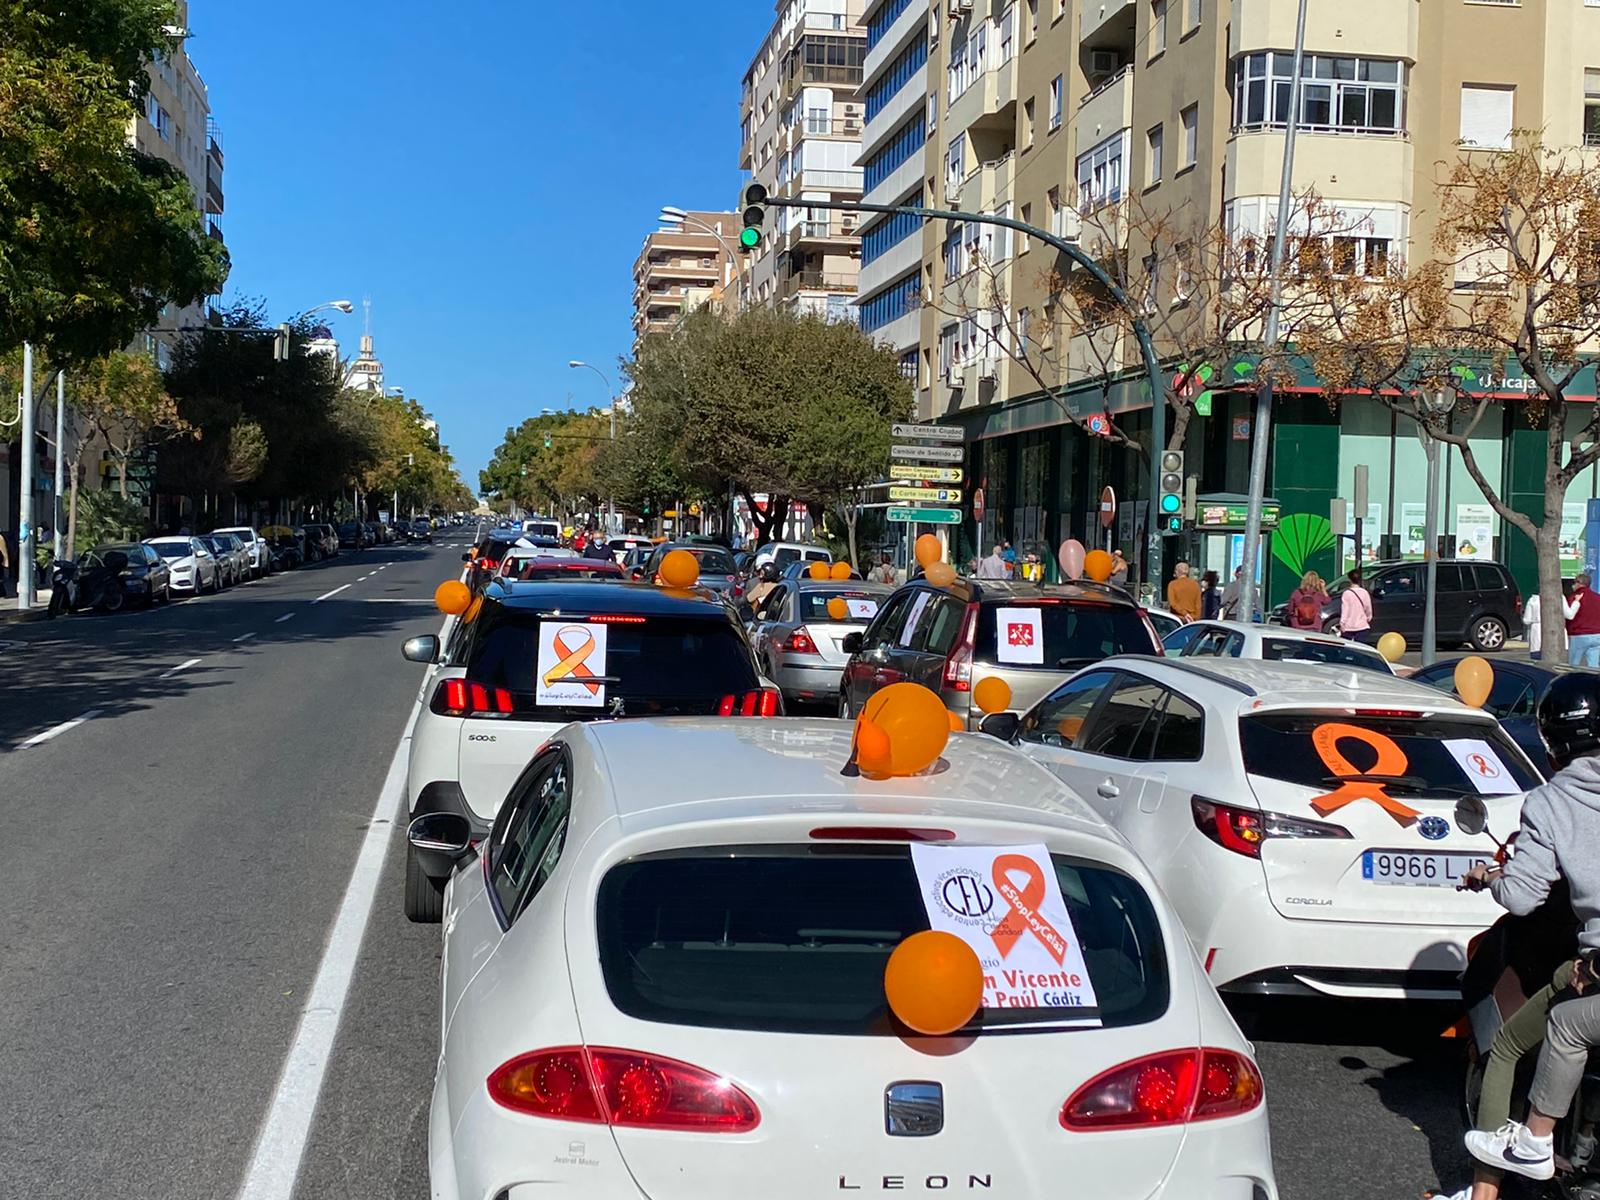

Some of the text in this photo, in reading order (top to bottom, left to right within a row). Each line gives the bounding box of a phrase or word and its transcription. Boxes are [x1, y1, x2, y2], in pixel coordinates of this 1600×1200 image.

[912, 426, 937, 434] Centro
[1378, 855, 1437, 879] 9966
[1285, 897, 1333, 905] COROLLA
[1002, 970, 1081, 988] Vicente
[995, 990, 1039, 1007] Paúl
[1043, 991, 1082, 1006] Cádiz
[839, 1174, 992, 1190] LEON
